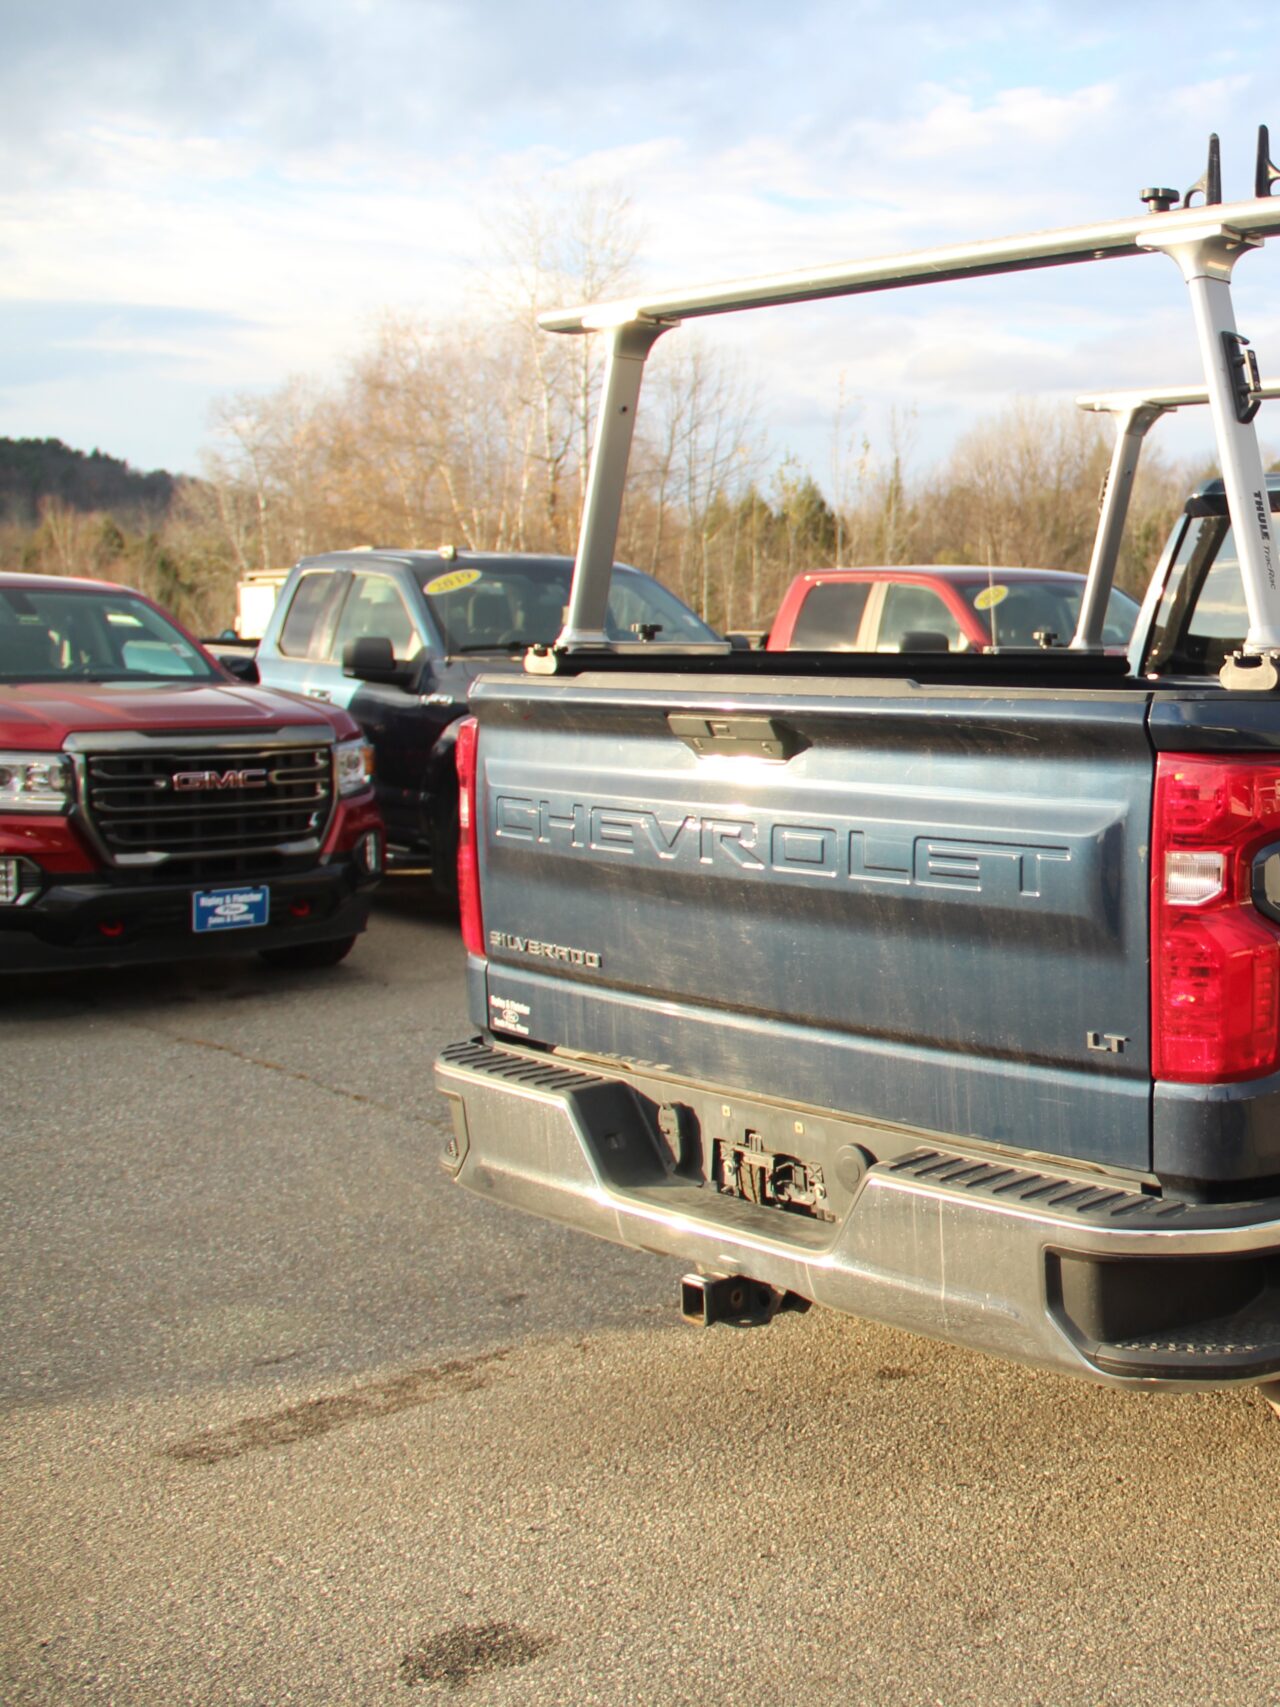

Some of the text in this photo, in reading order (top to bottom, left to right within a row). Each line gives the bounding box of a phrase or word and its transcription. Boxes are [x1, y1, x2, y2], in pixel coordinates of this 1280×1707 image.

[1253, 490, 1270, 541] THULE
[172, 768, 266, 791] GMC
[495, 795, 1072, 896] CHEVROLET
[489, 930, 602, 968] SILVERADO
[1086, 1031, 1126, 1053] LT
